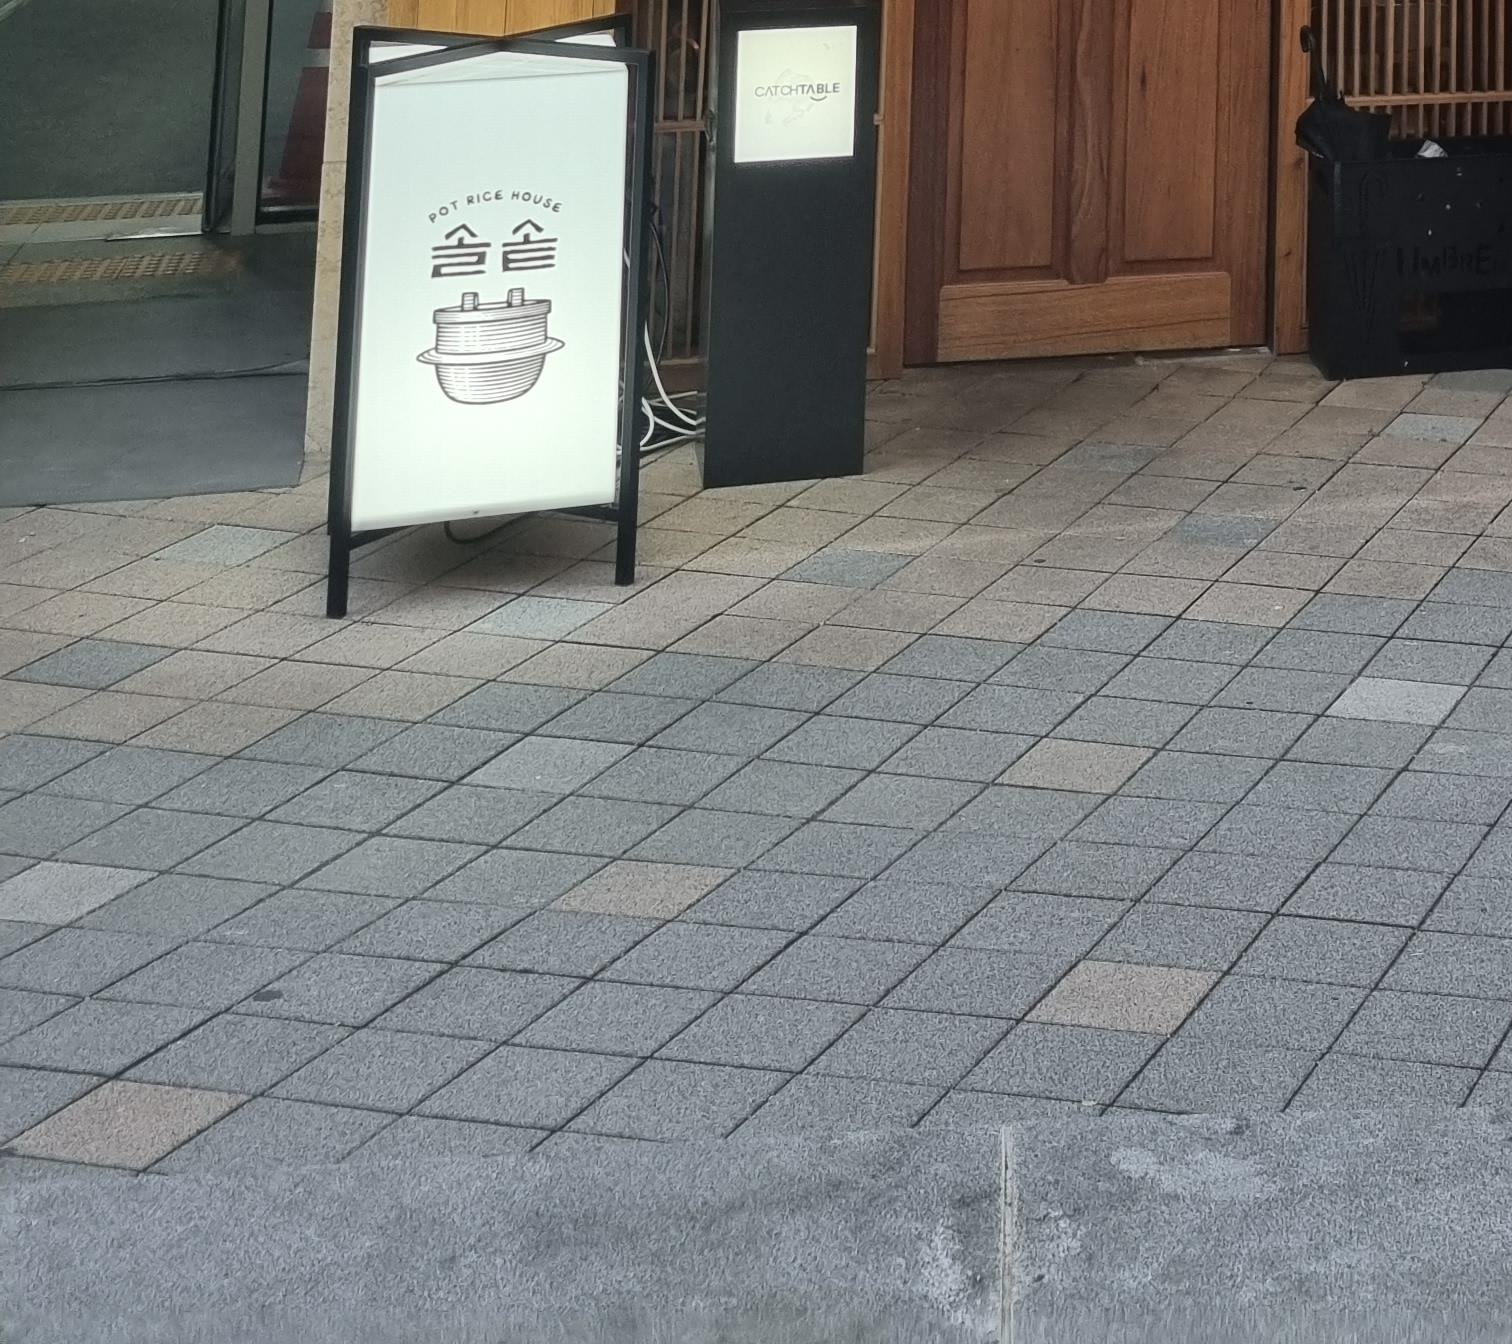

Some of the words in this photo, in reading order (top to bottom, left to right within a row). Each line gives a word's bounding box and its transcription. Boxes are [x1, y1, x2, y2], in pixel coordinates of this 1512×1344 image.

[428, 198, 459, 224] POT
[466, 189, 504, 206] RICE
[511, 189, 563, 213] HOUSE
[430, 218, 558, 279] 솔솥
